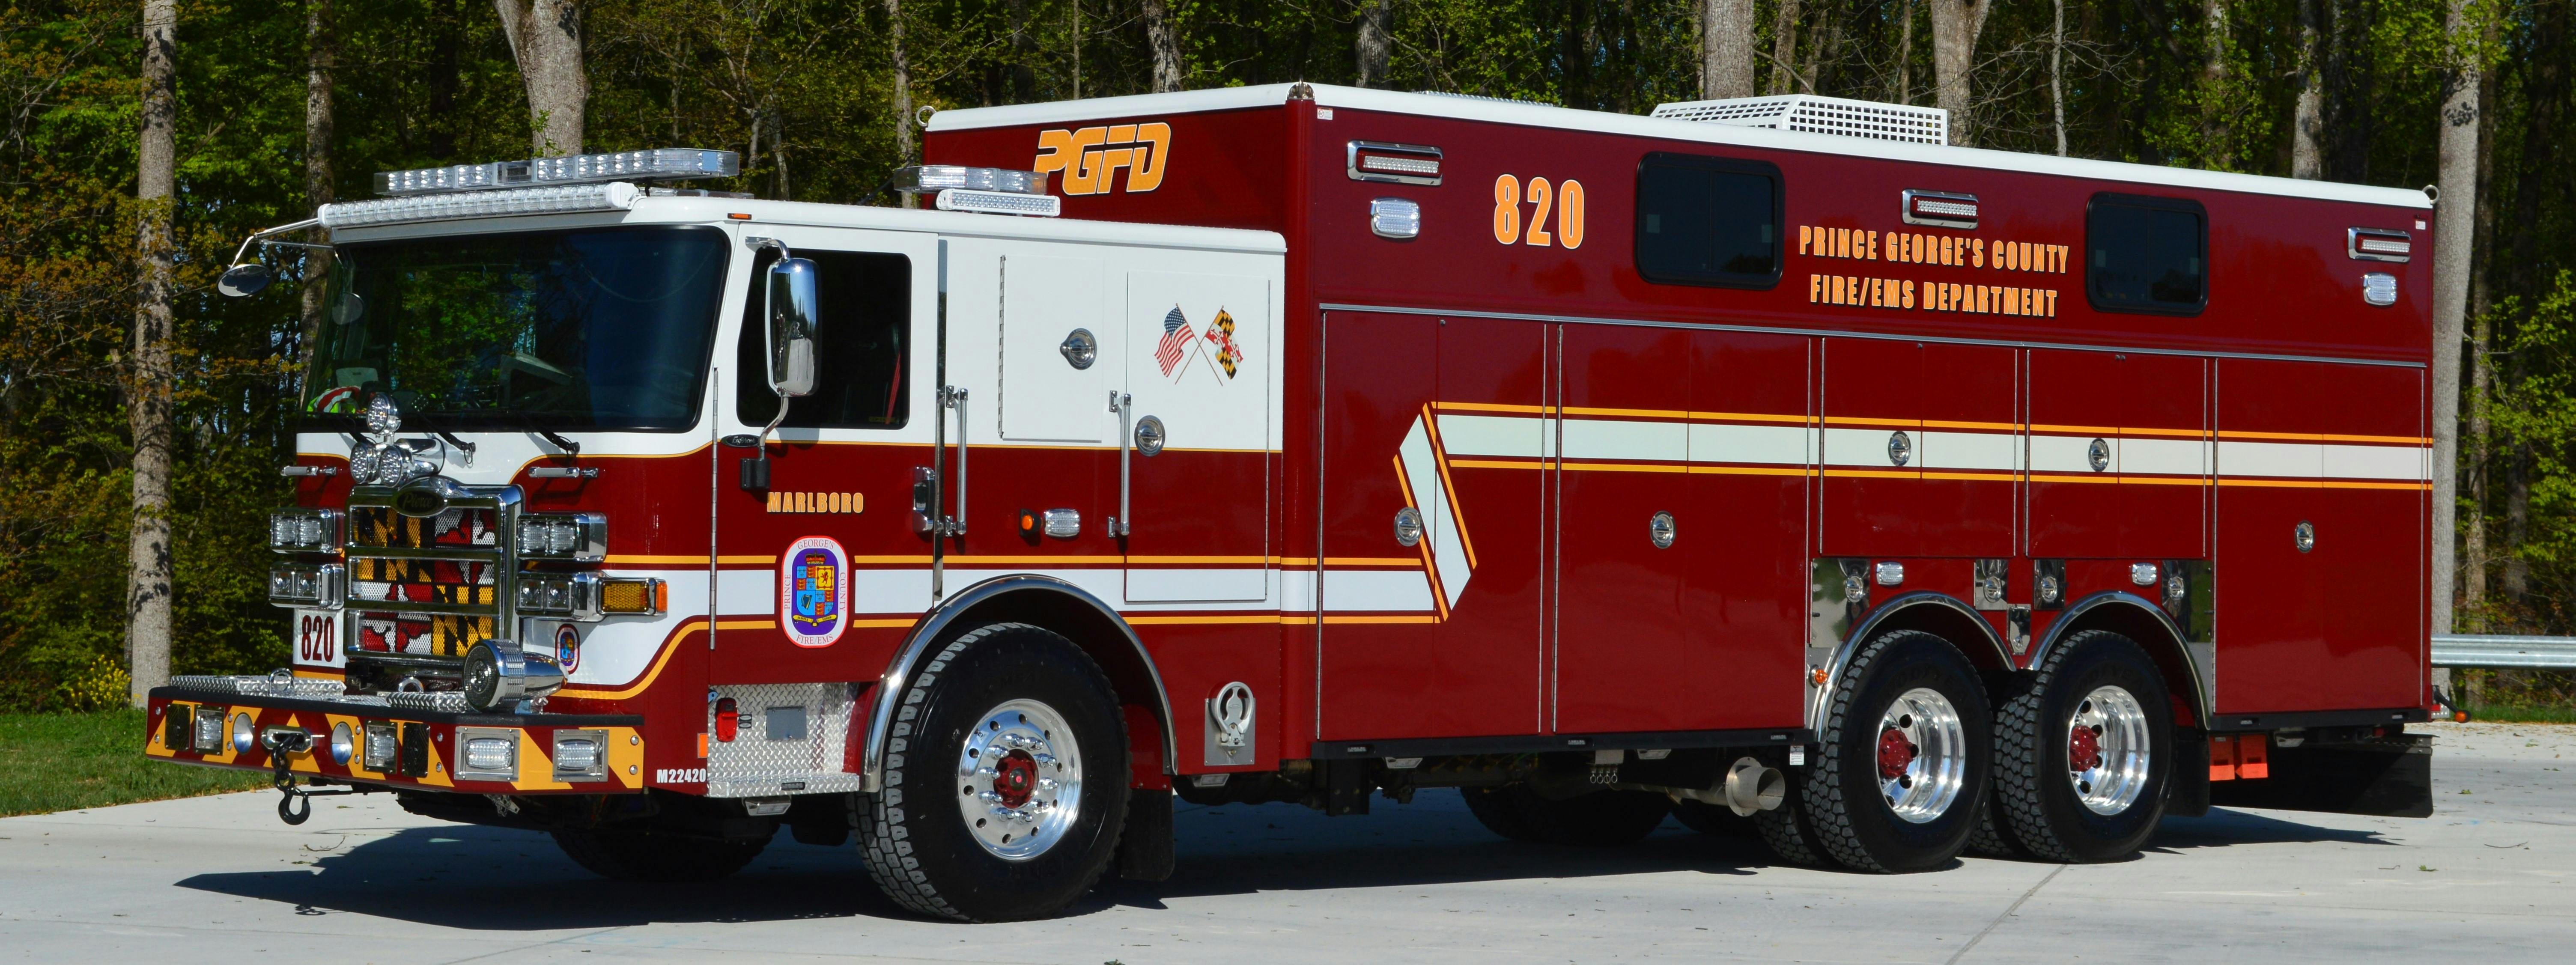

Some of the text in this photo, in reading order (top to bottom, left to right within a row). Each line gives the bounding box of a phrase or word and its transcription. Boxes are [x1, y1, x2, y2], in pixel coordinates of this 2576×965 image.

[1034, 122, 1171, 195] PGFD
[1494, 173, 1584, 249] 820
[1800, 225, 2069, 274] PRINCE GEORGE'S COUNTY
[1810, 274, 2057, 317] FIRE/EMS DEPARTMENT
[767, 492, 864, 513] MARLBORO
[798, 539, 835, 549] GEORGE'S
[301, 615, 334, 662] 820
[796, 634, 833, 644] FIRE/EMS
[657, 768, 706, 783] M22420
